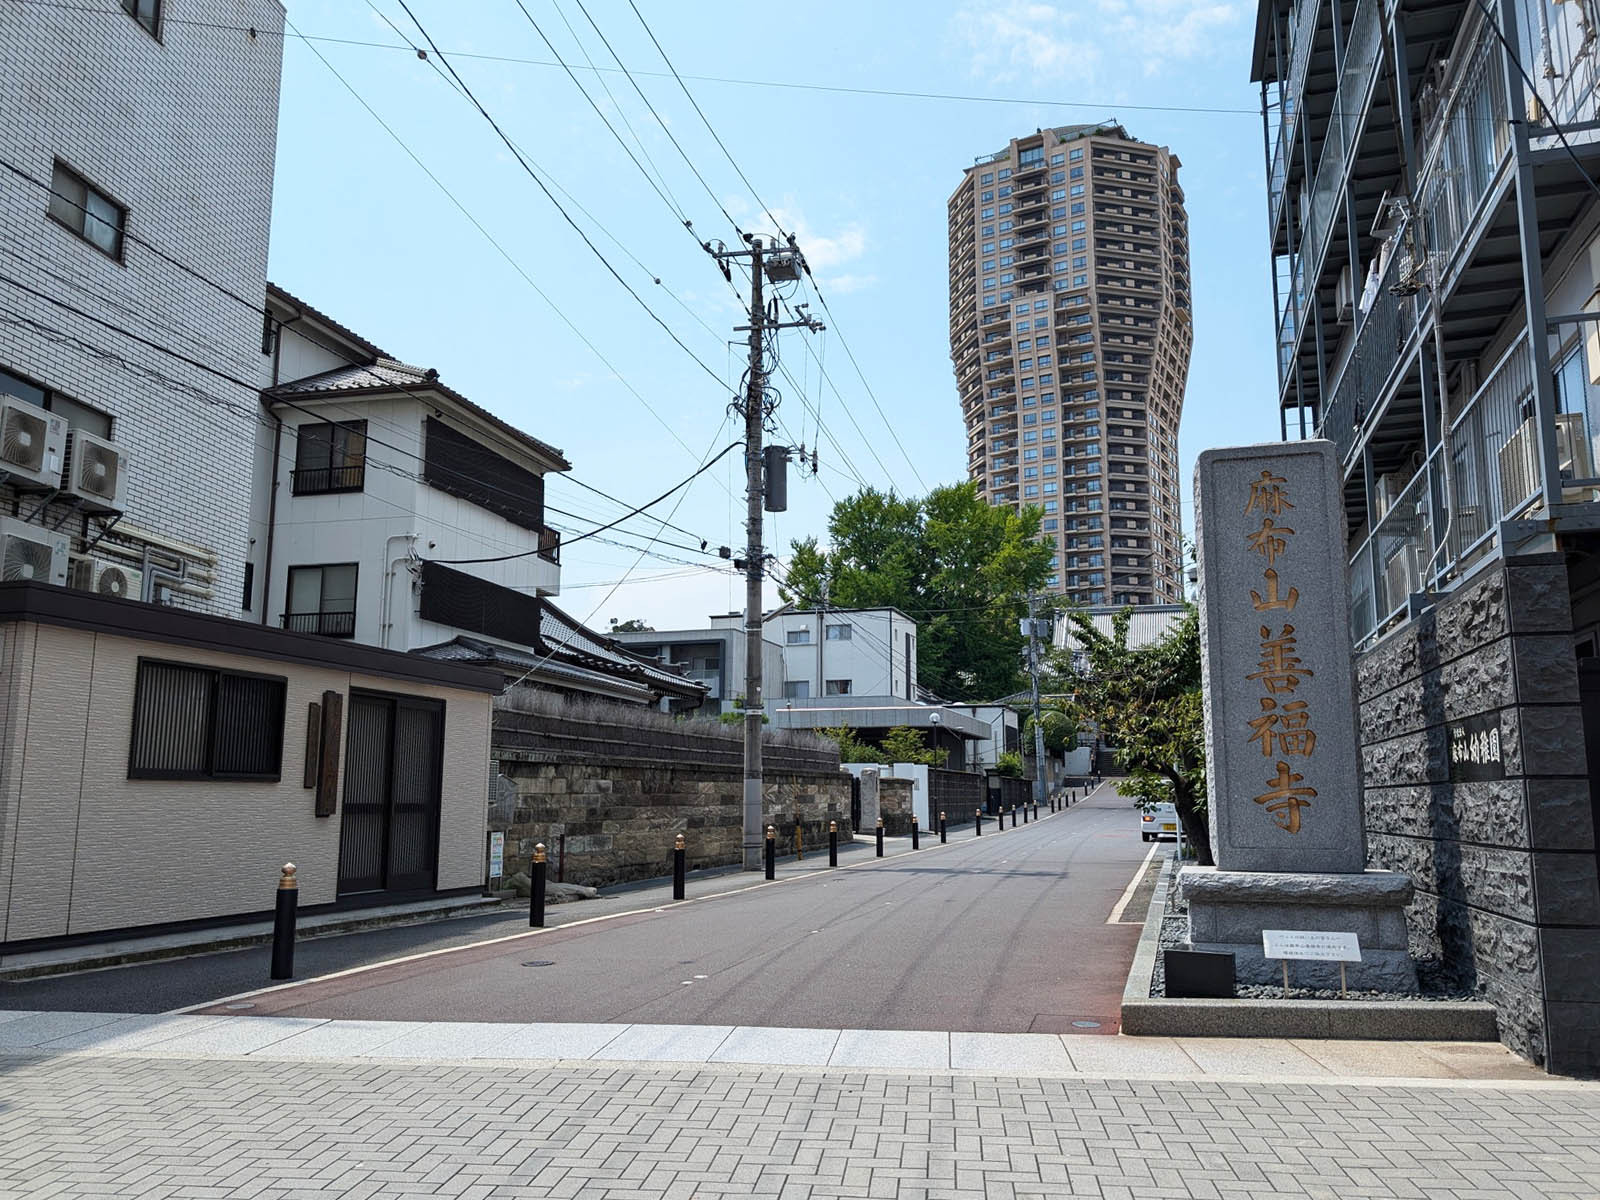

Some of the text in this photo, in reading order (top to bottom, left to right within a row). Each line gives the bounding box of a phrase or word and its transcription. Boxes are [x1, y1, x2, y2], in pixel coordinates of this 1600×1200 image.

[1243, 470, 1318, 834] 麻布山善福寺
